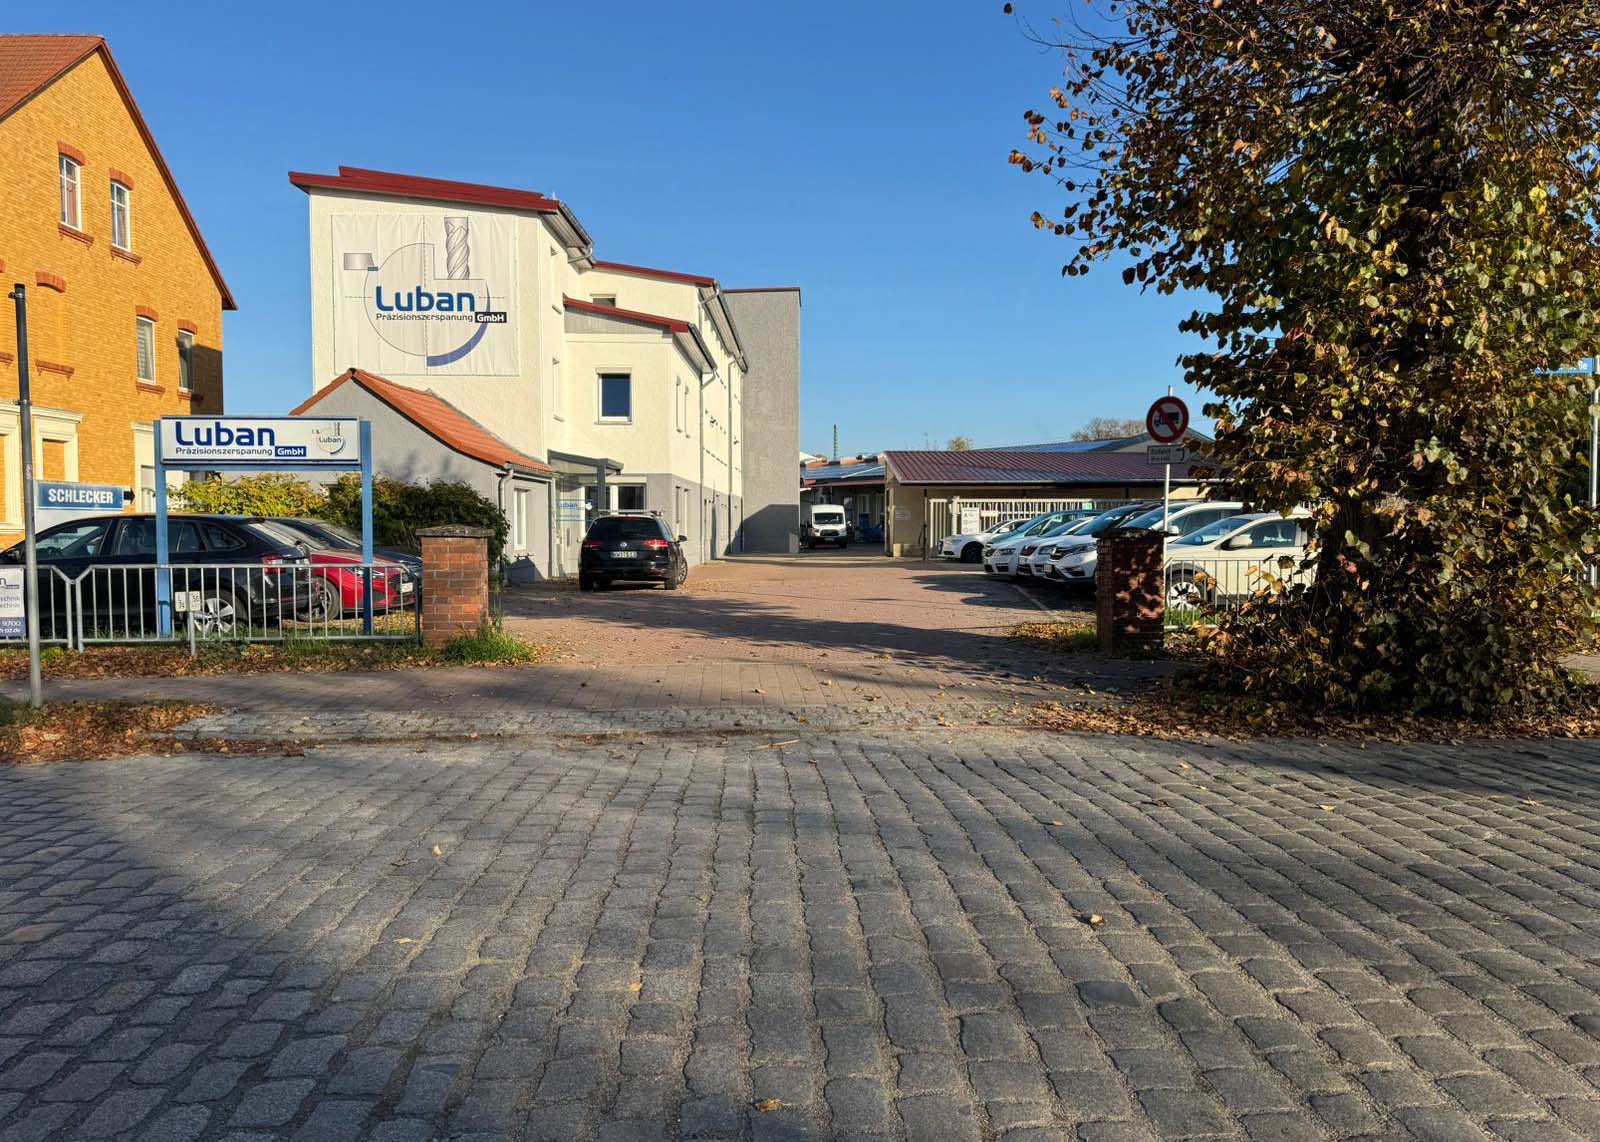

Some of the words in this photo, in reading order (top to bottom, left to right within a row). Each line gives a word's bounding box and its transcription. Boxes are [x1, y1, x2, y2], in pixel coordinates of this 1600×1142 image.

[376, 286, 475, 312] Luban
[376, 312, 473, 322] Präzisionszerspanung
[477, 313, 505, 322] GmbH
[175, 421, 275, 446] Luban
[175, 446, 273, 456] Präzisionszerspanung
[277, 447, 304, 456] GmbH
[47, 488, 113, 504] SCHLECKER
